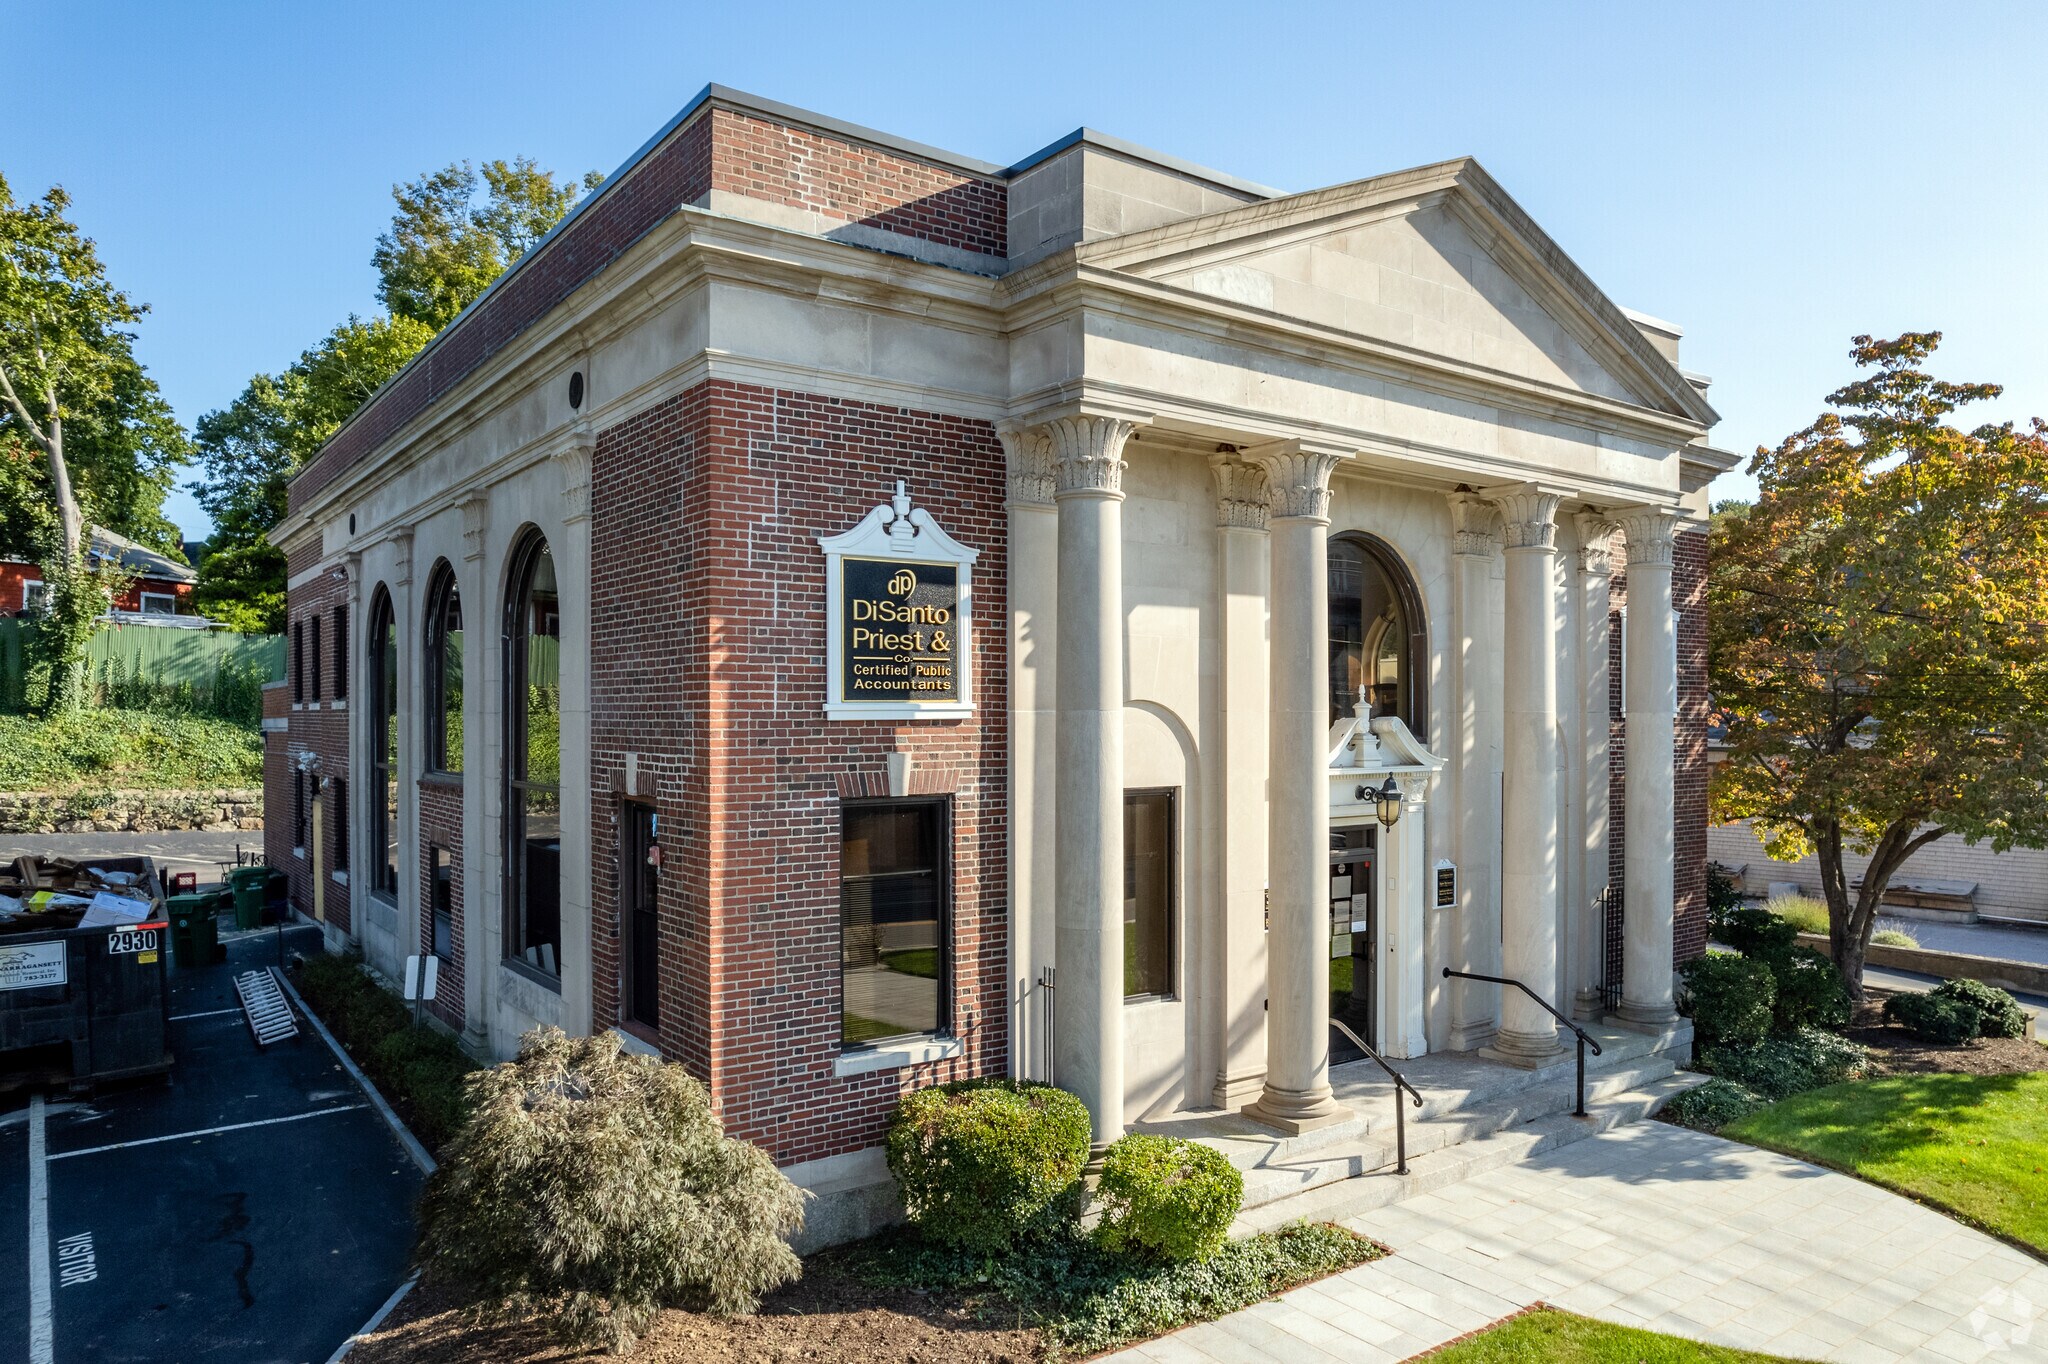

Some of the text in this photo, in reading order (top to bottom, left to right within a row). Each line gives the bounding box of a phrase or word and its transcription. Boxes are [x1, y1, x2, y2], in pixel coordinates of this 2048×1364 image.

[853, 599, 950, 625] DiSanto
[853, 627, 950, 652] Priest &
[854, 664, 952, 676] Certified Public
[894, 654, 913, 663] Co.
[853, 678, 951, 690] Accountants
[110, 930, 156, 953] 2930
[58, 1231, 98, 1288] VISITOR
